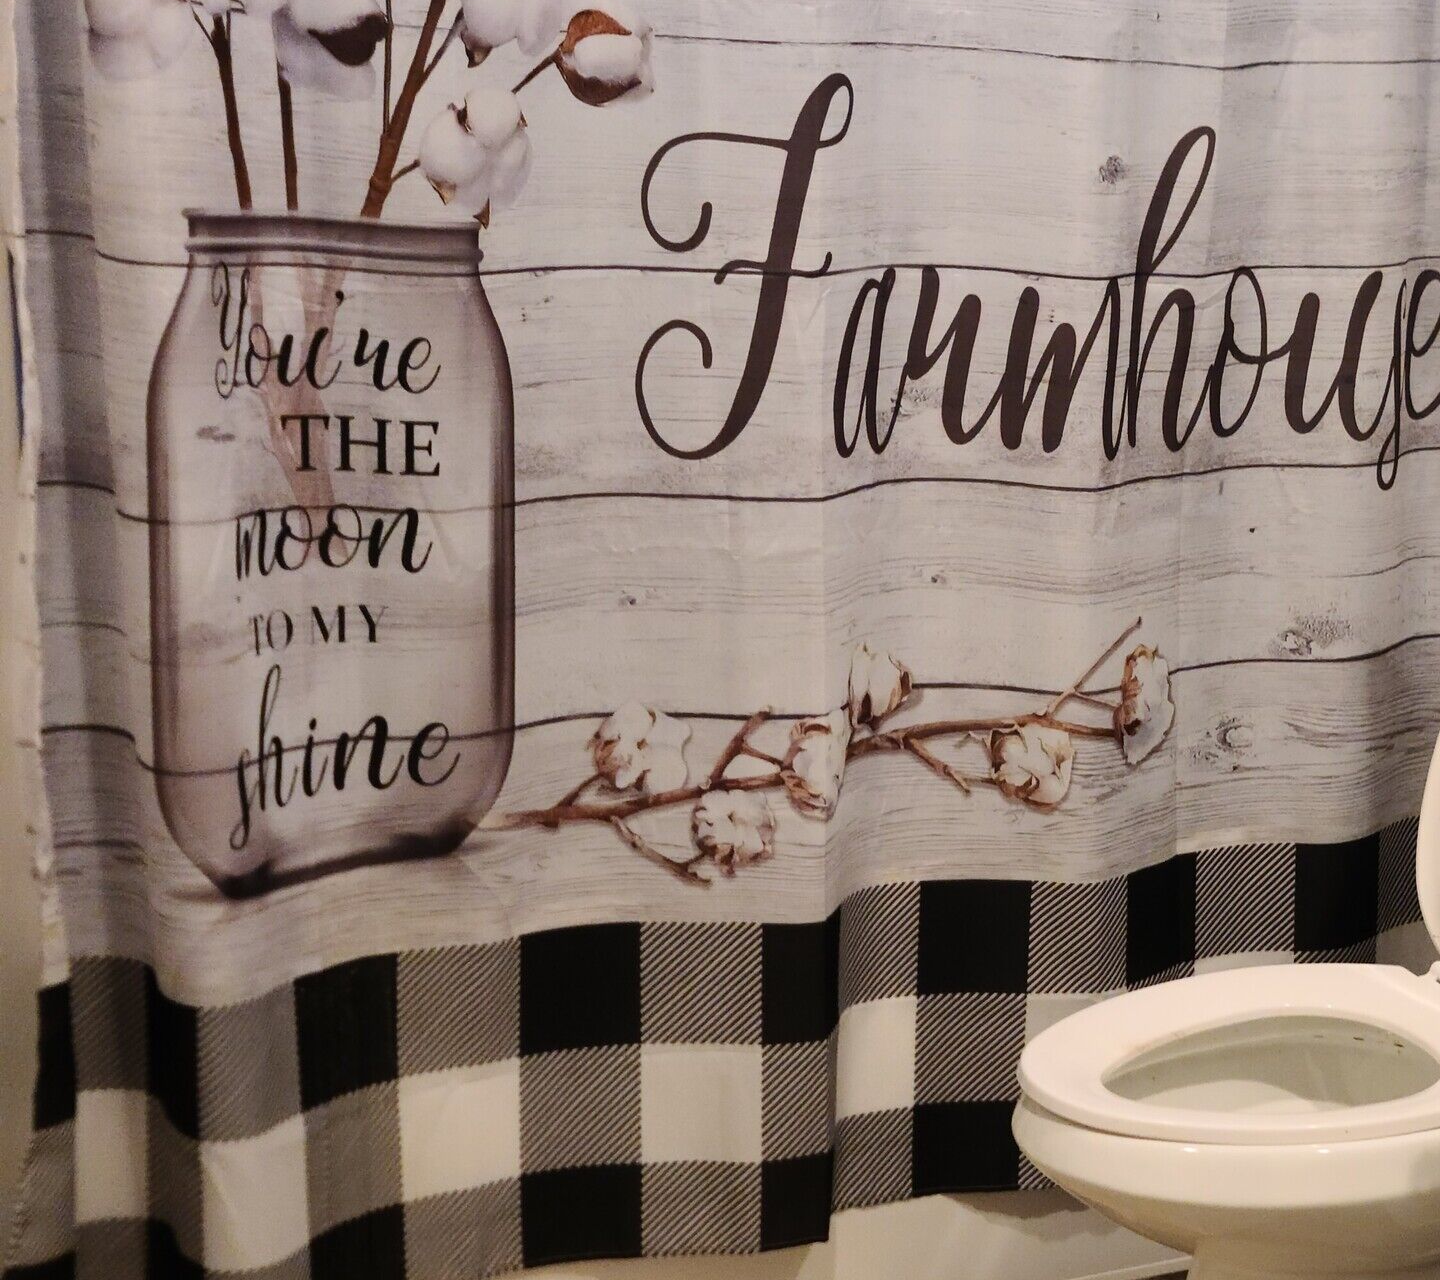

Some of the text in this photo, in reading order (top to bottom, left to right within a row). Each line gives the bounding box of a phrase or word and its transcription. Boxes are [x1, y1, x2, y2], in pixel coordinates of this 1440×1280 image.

[210, 260, 442, 400] You're
[280, 414, 441, 478] THE
[234, 504, 434, 582] moon
[247, 603, 390, 657] TO MY
[229, 663, 463, 851] shine
